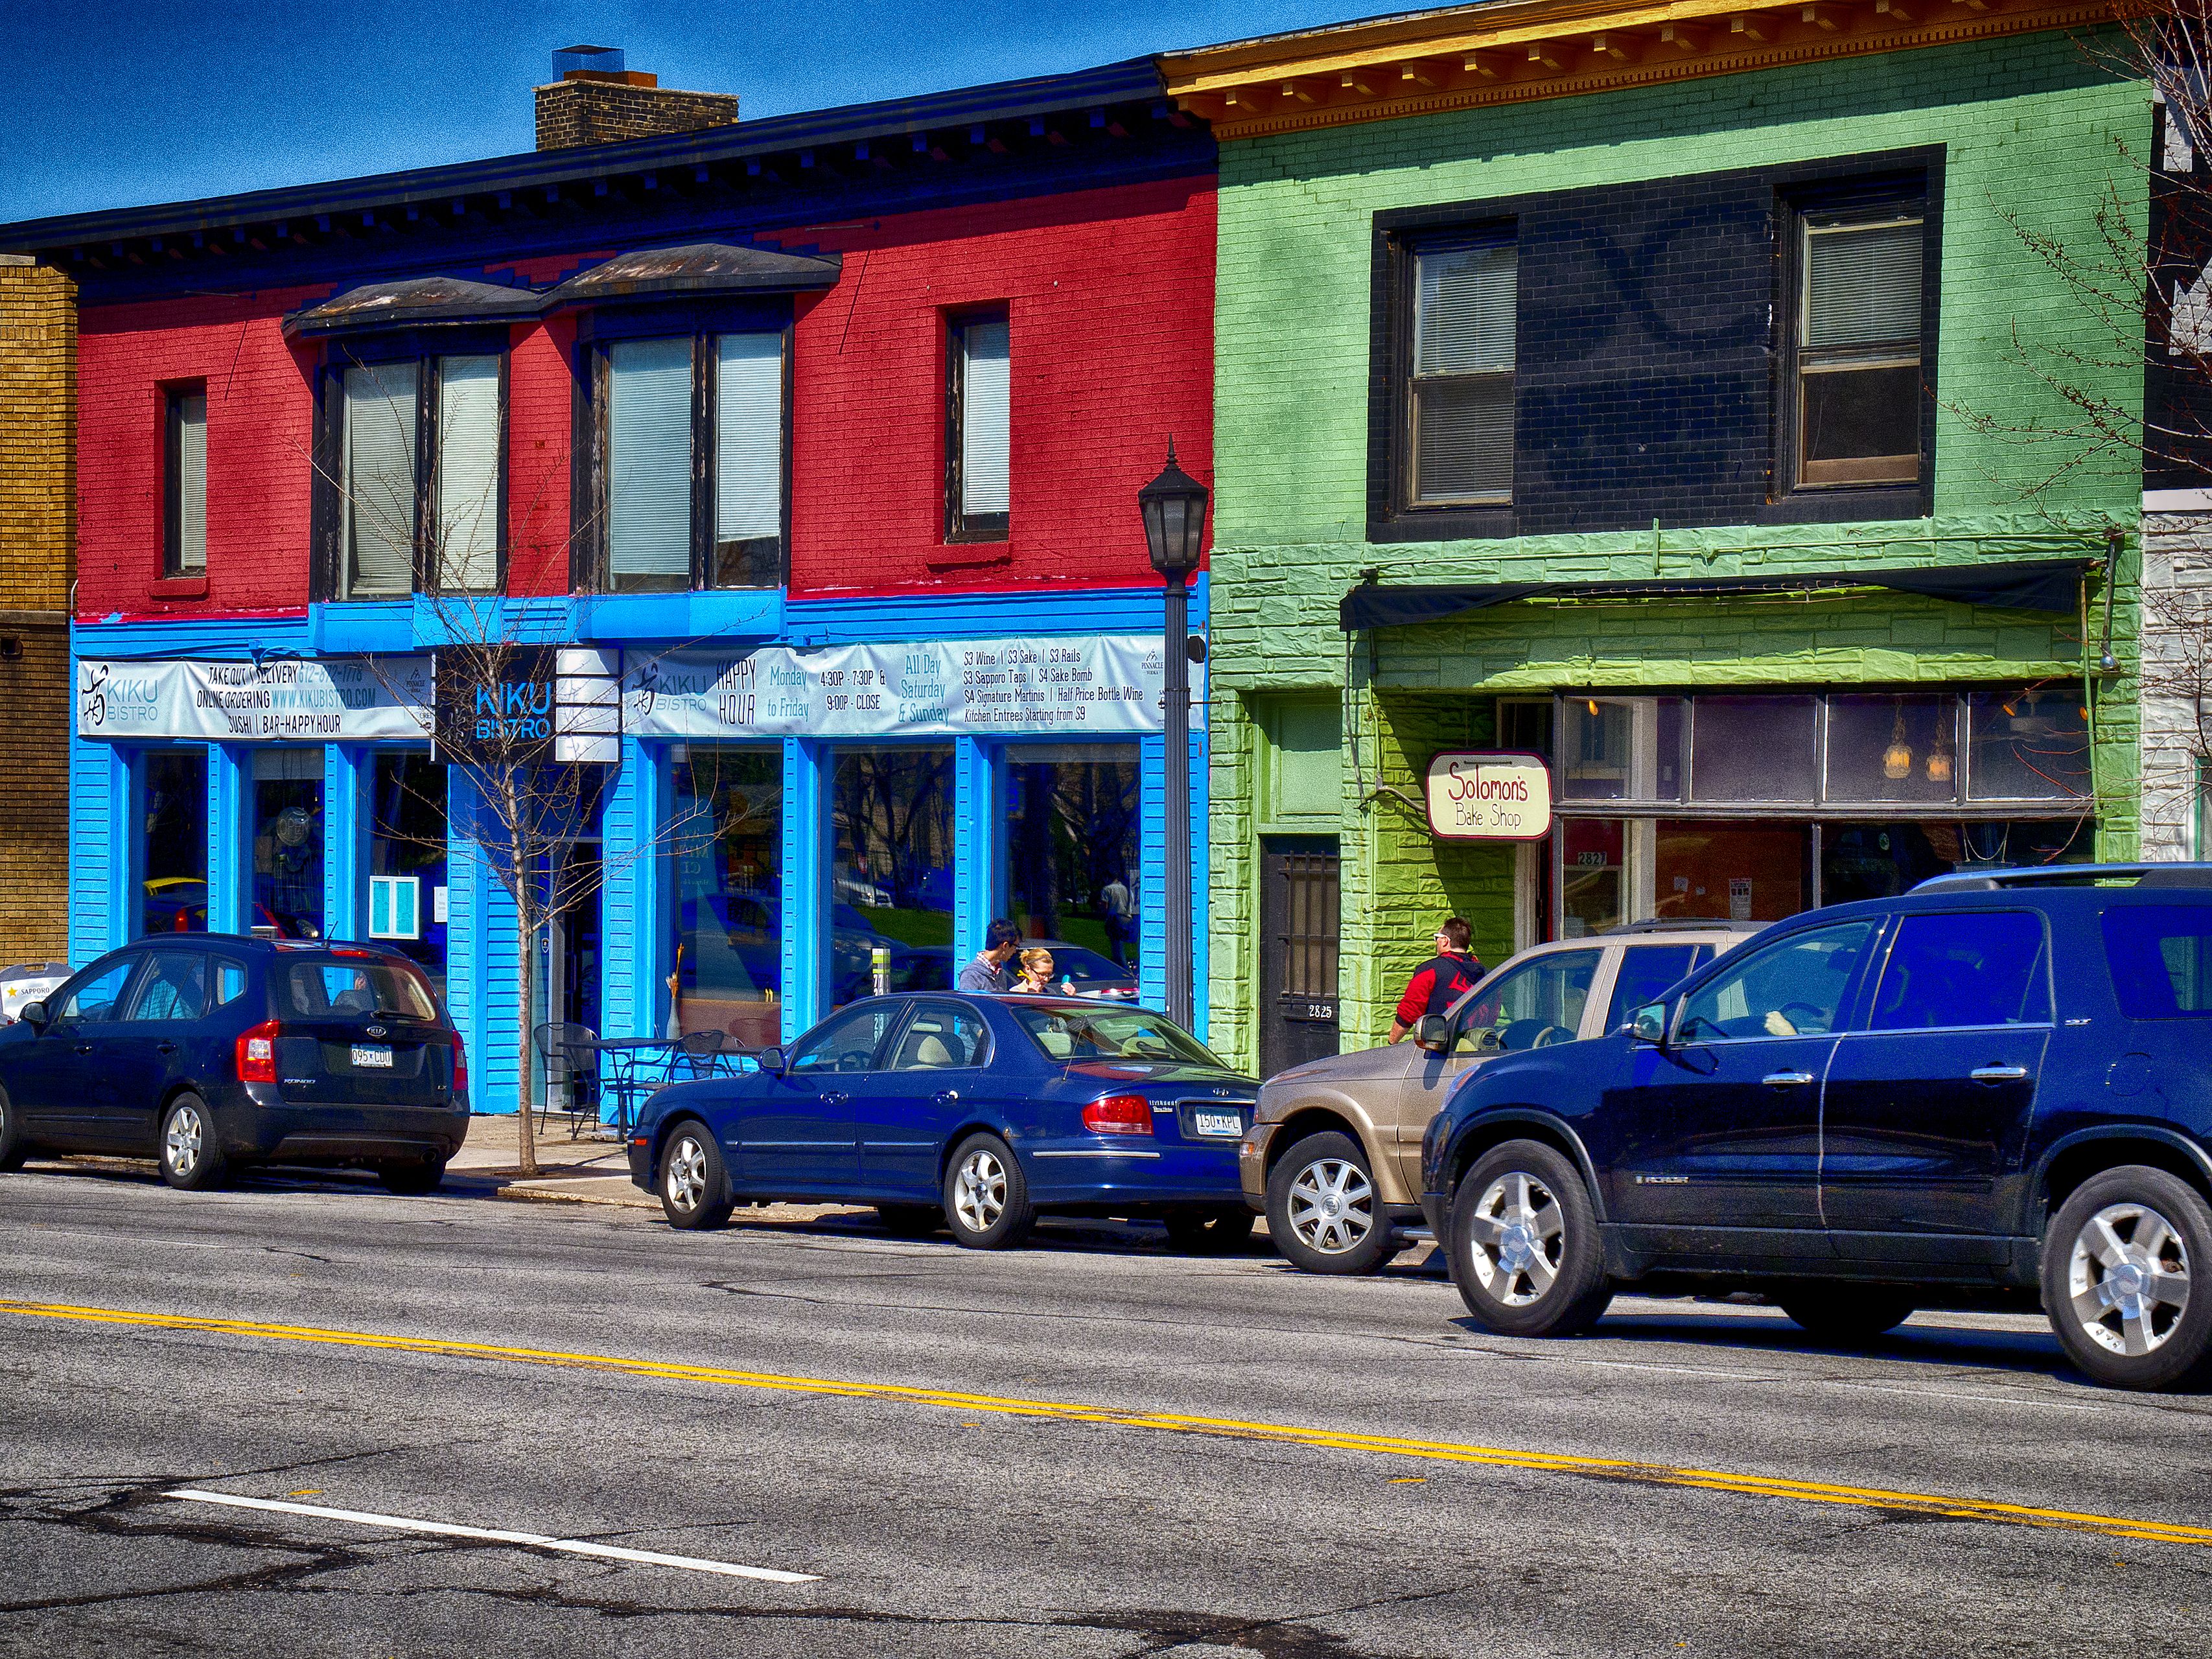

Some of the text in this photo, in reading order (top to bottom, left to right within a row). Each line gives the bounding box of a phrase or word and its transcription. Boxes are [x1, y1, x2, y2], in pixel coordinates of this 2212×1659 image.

[905, 654, 941, 679] All Day
[975, 651, 995, 665] Wine
[1019, 649, 1037, 664] Sake
[1061, 648, 1080, 663] Rails
[208, 666, 229, 686] TAKE
[229, 667, 246, 686] OUT
[255, 665, 298, 684] DELIVERY
[716, 658, 757, 691] HAPPY
[769, 666, 808, 691] Monday
[820, 671, 844, 687] 4:30P
[852, 670, 874, 686] 7:30P
[975, 670, 1006, 688] Sapporo
[1008, 669, 1027, 688] Taps
[1051, 668, 1069, 682] Sake
[1072, 667, 1093, 682] Bomb
[106, 679, 159, 703] KIKU
[658, 675, 707, 696] KIKU
[900, 678, 946, 703] Saturday
[196, 688, 377, 709] ONLINE ORDERING WWW.KIKUBISTRO.COM
[476, 682, 551, 715] KIKU
[655, 698, 707, 712] BISTRO
[826, 695, 848, 710] 9:00P
[856, 694, 881, 710] CLOSE
[977, 689, 1012, 707] Signature
[1015, 688, 1045, 702] Martinis
[1058, 687, 1074, 702] Half
[1075, 688, 1095, 701] Price
[1097, 686, 1121, 701] Bottle
[1123, 686, 1143, 701] Wine
[107, 706, 158, 721] BISTRO
[719, 694, 756, 725] HOUR
[767, 697, 809, 722] to Friday
[898, 702, 949, 726] & Sunday
[964, 708, 992, 723] Kitchen
[994, 708, 1023, 722] Entrees
[1025, 707, 1054, 725] Starting
[1056, 706, 1073, 721] from
[228, 715, 253, 734] SUSHI
[317, 714, 341, 734] HOUR
[476, 718, 550, 739] BISTRO
[1448, 761, 1528, 802] Solomon's
[1455, 802, 1521, 831] Bake Shop
[21, 987, 50, 995] SAPPORO
[1309, 1004, 1333, 1019] 2825
[352, 1050, 368, 1062] 095
[1200, 1114, 1239, 1129] 150 KPL
